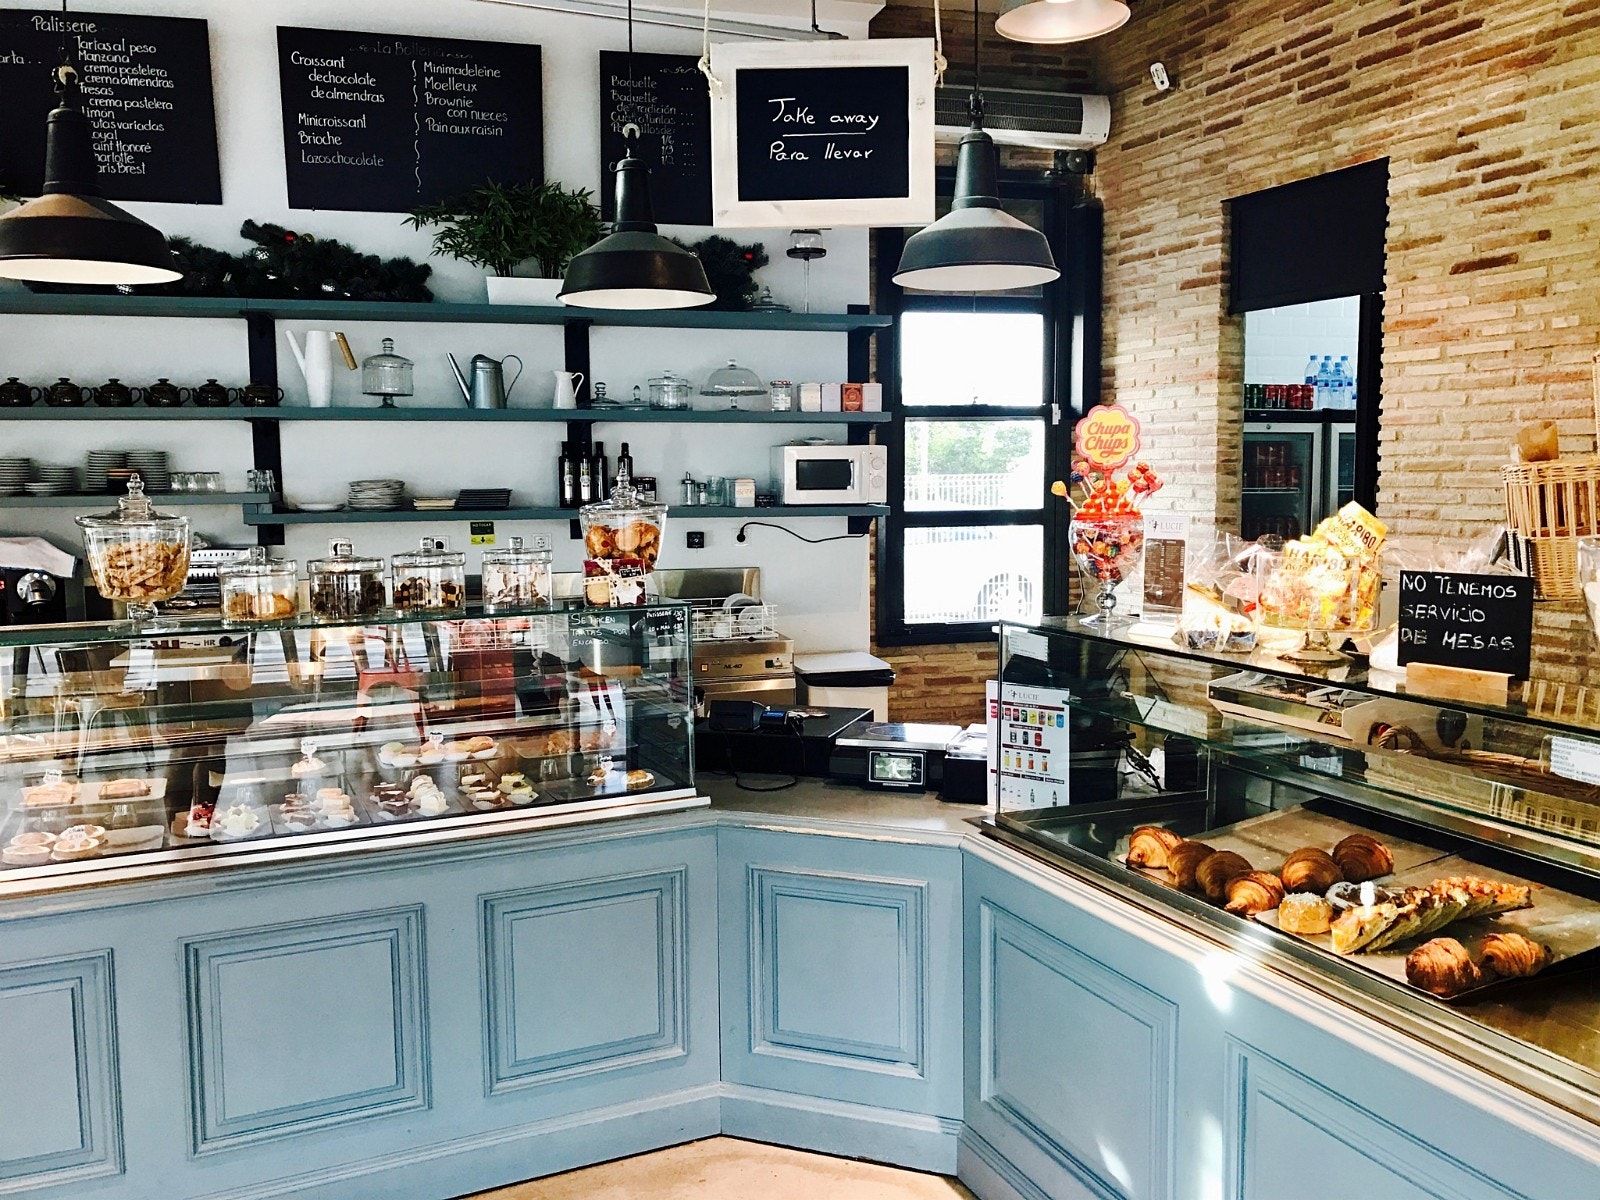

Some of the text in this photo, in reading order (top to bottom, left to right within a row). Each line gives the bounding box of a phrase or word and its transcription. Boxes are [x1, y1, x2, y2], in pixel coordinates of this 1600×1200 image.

[73, 35, 157, 56] Tartas al peso
[376, 41, 391, 54] La
[78, 50, 130, 63] Manzana
[291, 51, 345, 69] Croissant
[84, 63, 168, 77] crema pastelera
[423, 61, 502, 78] Minimadeleine
[85, 75, 174, 88] crema almendras
[424, 76, 478, 92] Moelleux
[326, 87, 385, 103] almendras
[423, 91, 474, 108] Brownie
[89, 97, 173, 111] crema pastelera
[298, 112, 367, 129] Minicroissant
[447, 107, 508, 122] con nueces
[768, 97, 879, 131] Take away
[117, 119, 165, 132] variadas
[425, 117, 503, 137] Pain aux raisin
[91, 129, 118, 142] oyal
[298, 130, 343, 146] Brioche
[93, 140, 114, 152] aint
[769, 140, 873, 161] Para llevar
[1087, 421, 1131, 440] Chupa
[1085, 436, 1129, 457] Chups
[1160, 522, 1184, 531] LUCIE
[1402, 574, 1517, 599] NO TENEMOS
[571, 613, 586, 625] SE
[1401, 603, 1486, 622] SERVICIO
[570, 628, 627, 636] TARTAS POR
[1401, 628, 1515, 650] DE MESAS
